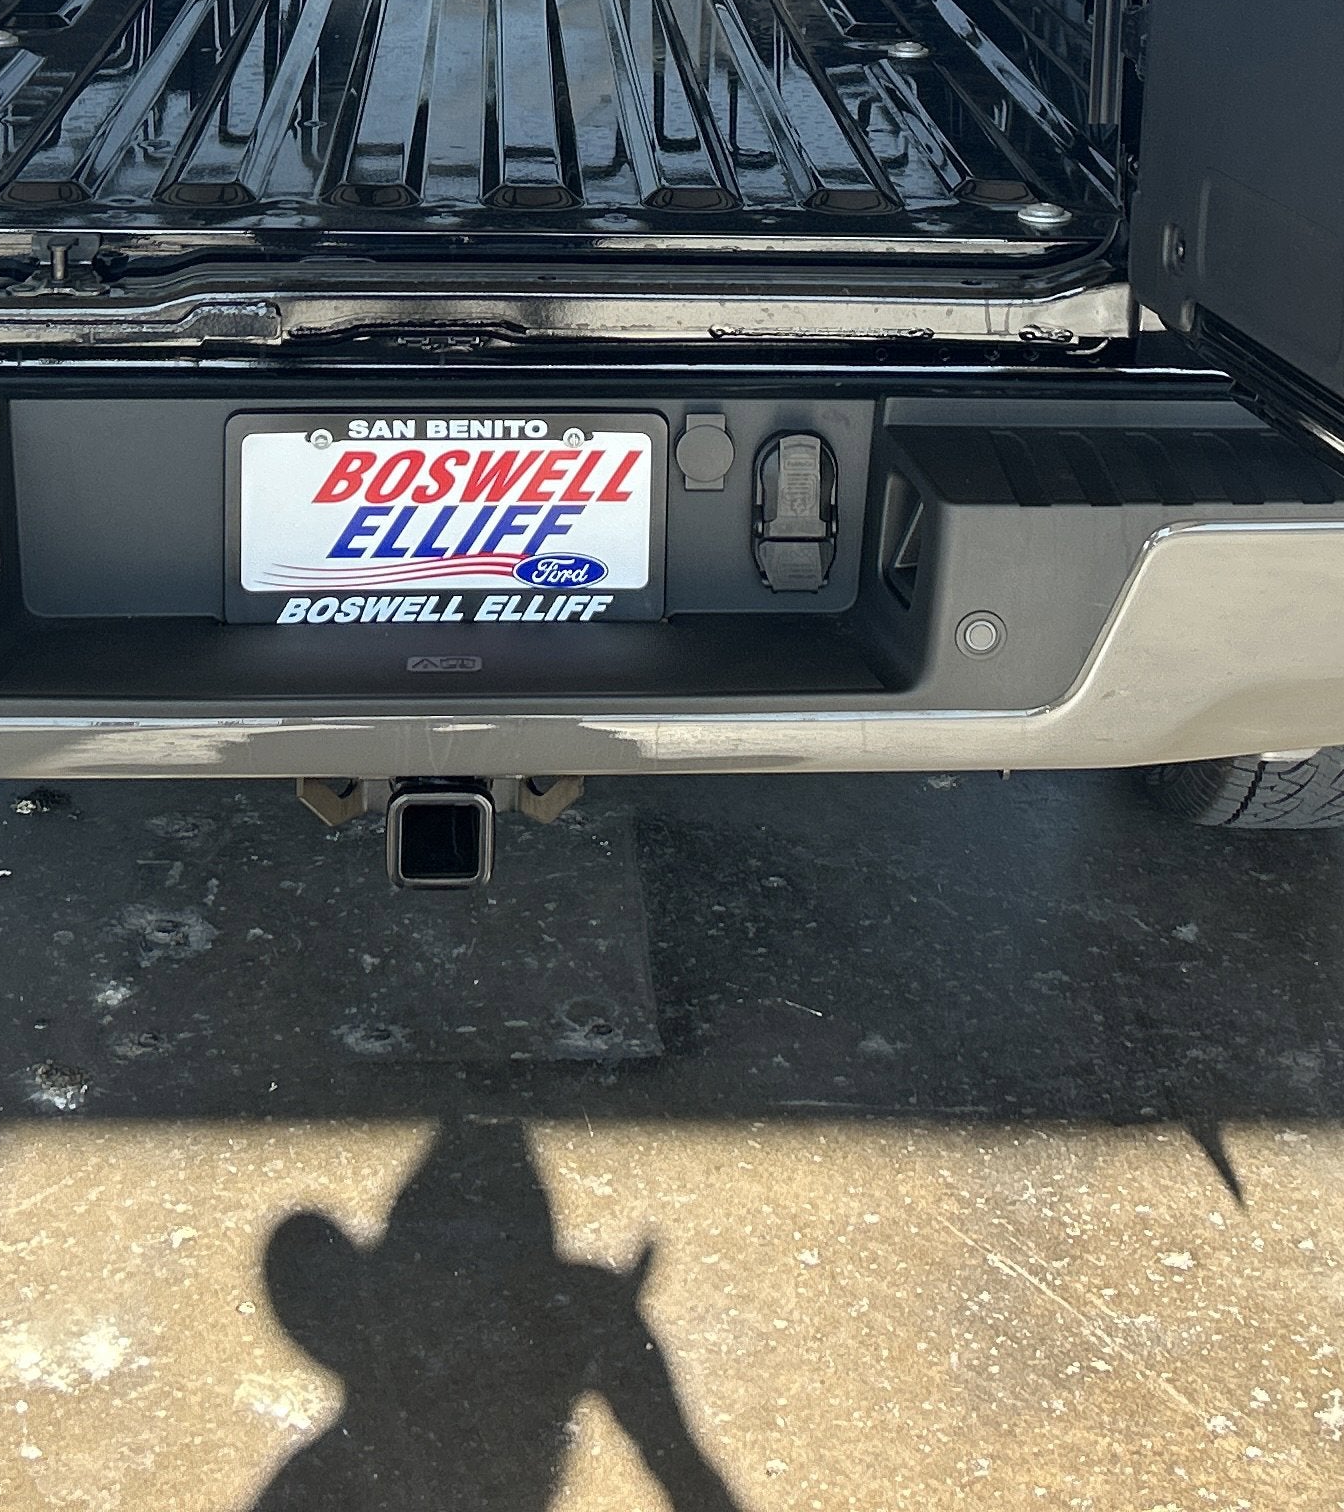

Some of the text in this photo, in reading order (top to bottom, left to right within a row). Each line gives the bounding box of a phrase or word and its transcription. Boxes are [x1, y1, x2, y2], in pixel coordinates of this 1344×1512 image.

[348, 419, 548, 439] SAN BENITO
[311, 449, 643, 504] BOSWELL
[325, 505, 587, 559] ELLIFF
[530, 558, 588, 585] Ford
[276, 595, 614, 624] BOSWELL ELLIFF
